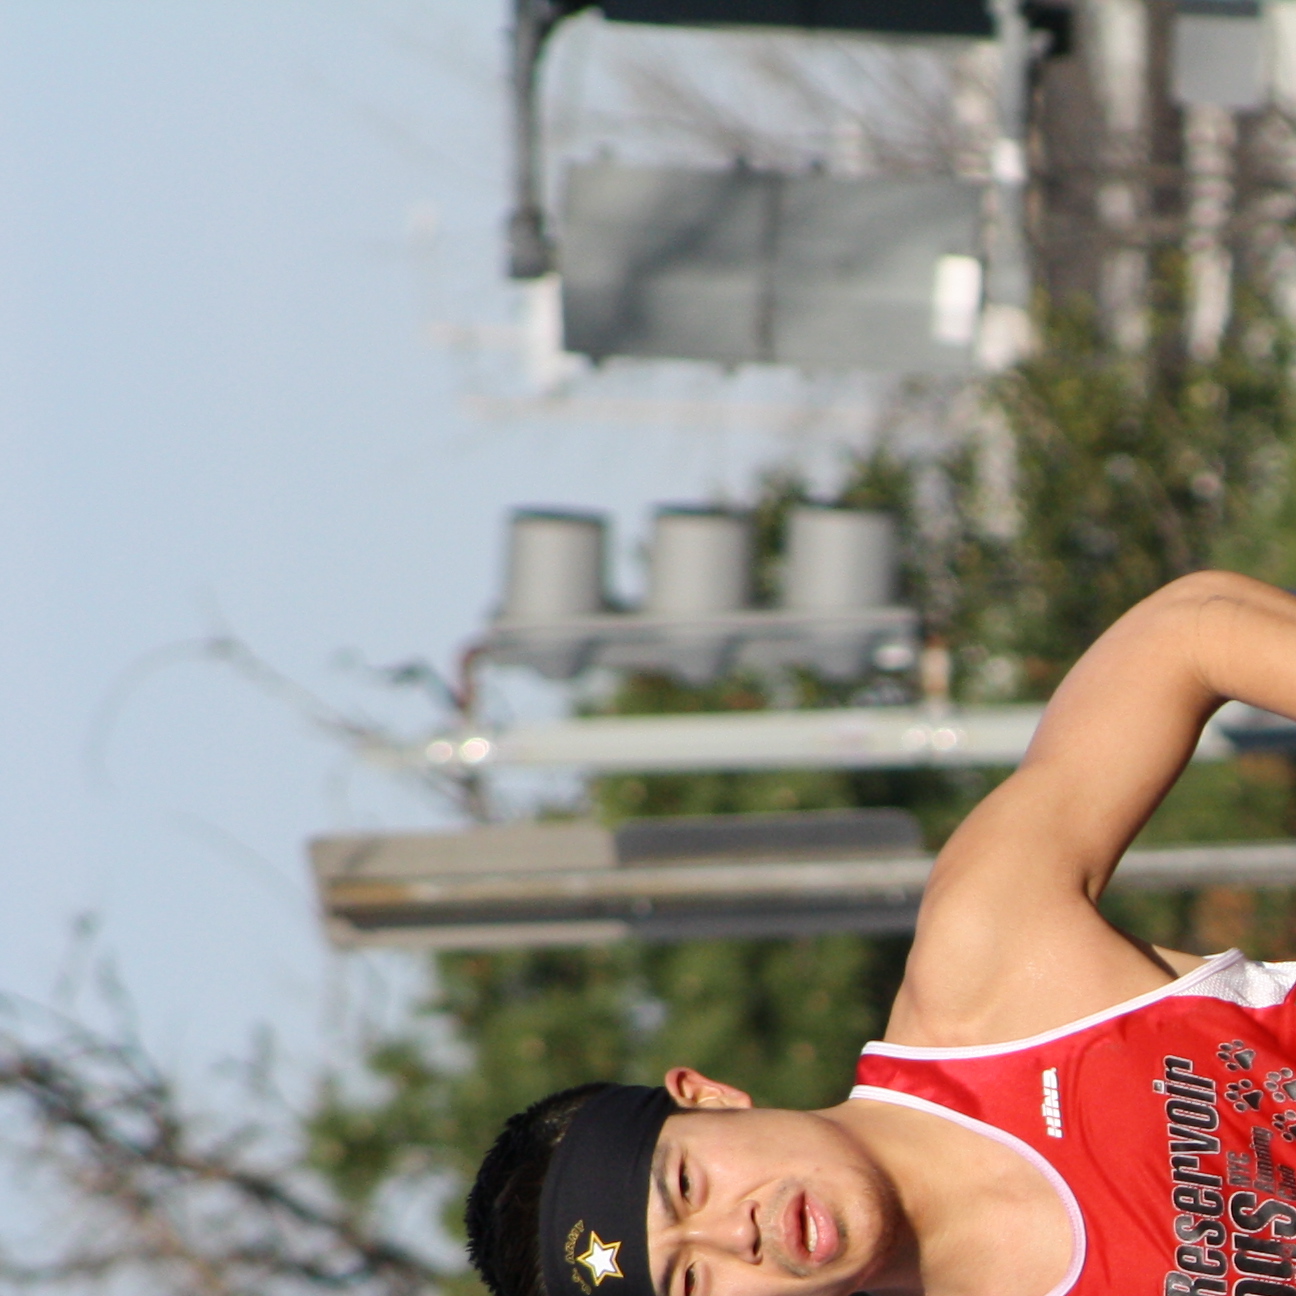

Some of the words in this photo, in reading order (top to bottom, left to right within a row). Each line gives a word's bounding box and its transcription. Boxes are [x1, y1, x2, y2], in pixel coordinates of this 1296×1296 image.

[1226, 1151, 1251, 1187] NYC
[1250, 1126, 1274, 1194] Running
[565, 1220, 585, 1264] ARMY
